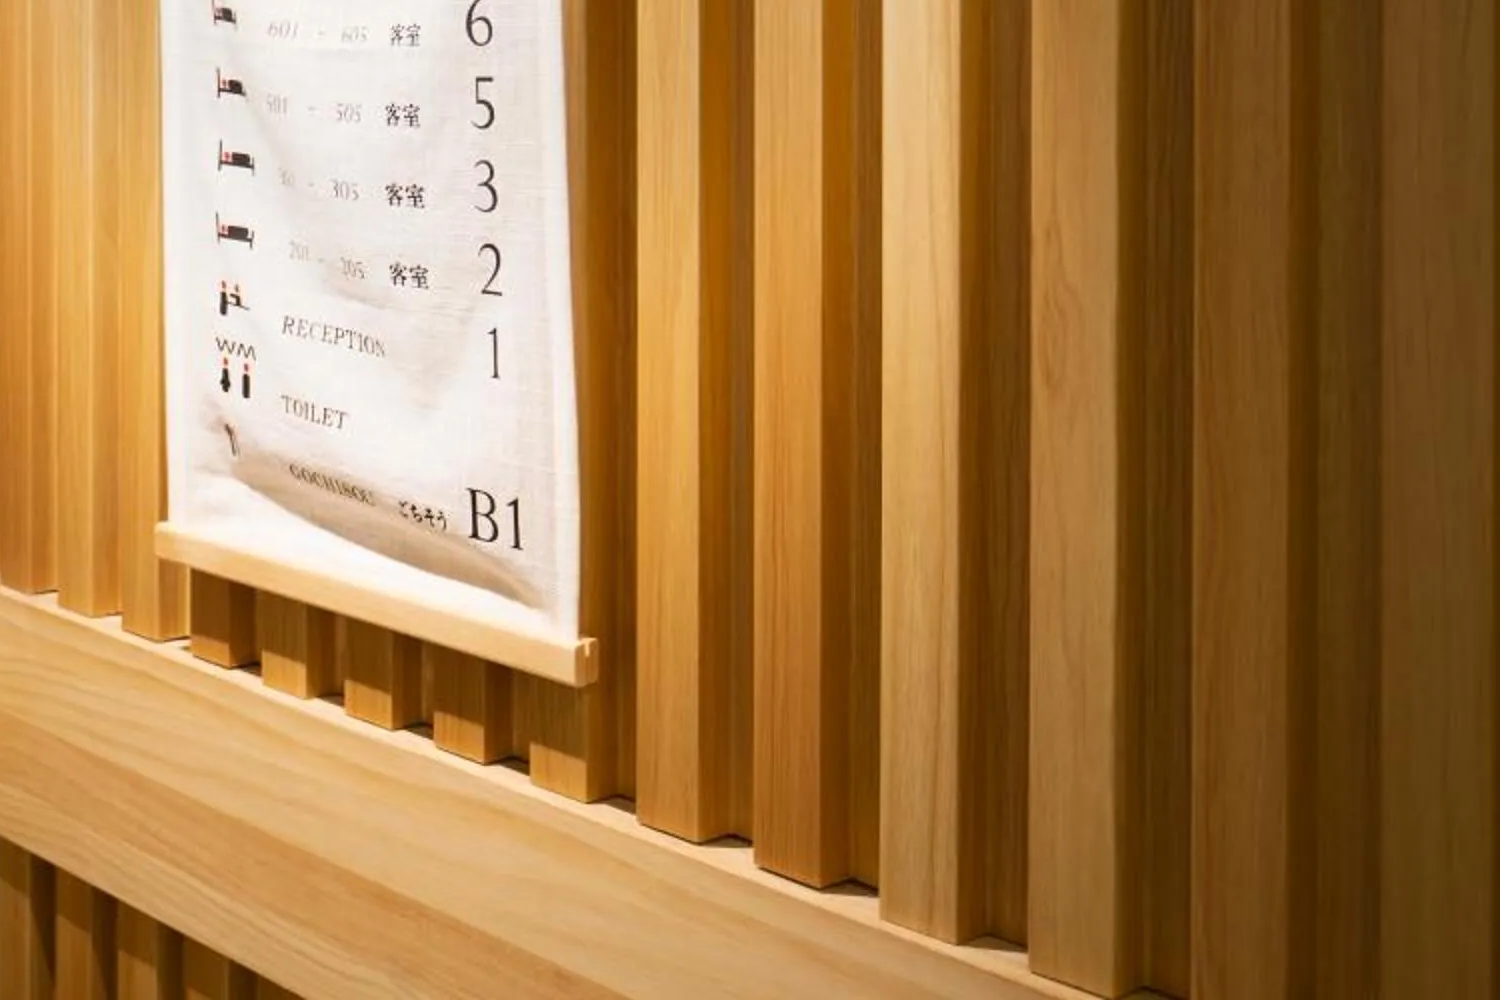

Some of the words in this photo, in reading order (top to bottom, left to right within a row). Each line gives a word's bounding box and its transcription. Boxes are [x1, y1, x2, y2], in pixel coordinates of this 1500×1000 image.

[389, 23, 422, 47] 客室
[335, 102, 361, 124] 505
[385, 102, 421, 129] 客室
[470, 76, 496, 130] 5
[329, 178, 360, 201] 305
[385, 182, 425, 209] 客室
[473, 159, 499, 214] 3
[389, 262, 429, 290] 客室
[478, 242, 503, 297] 2
[281, 315, 387, 359] RECEPTION
[487, 327, 500, 380] 1
[280, 394, 350, 431] TOILET
[465, 487, 524, 551] B1
